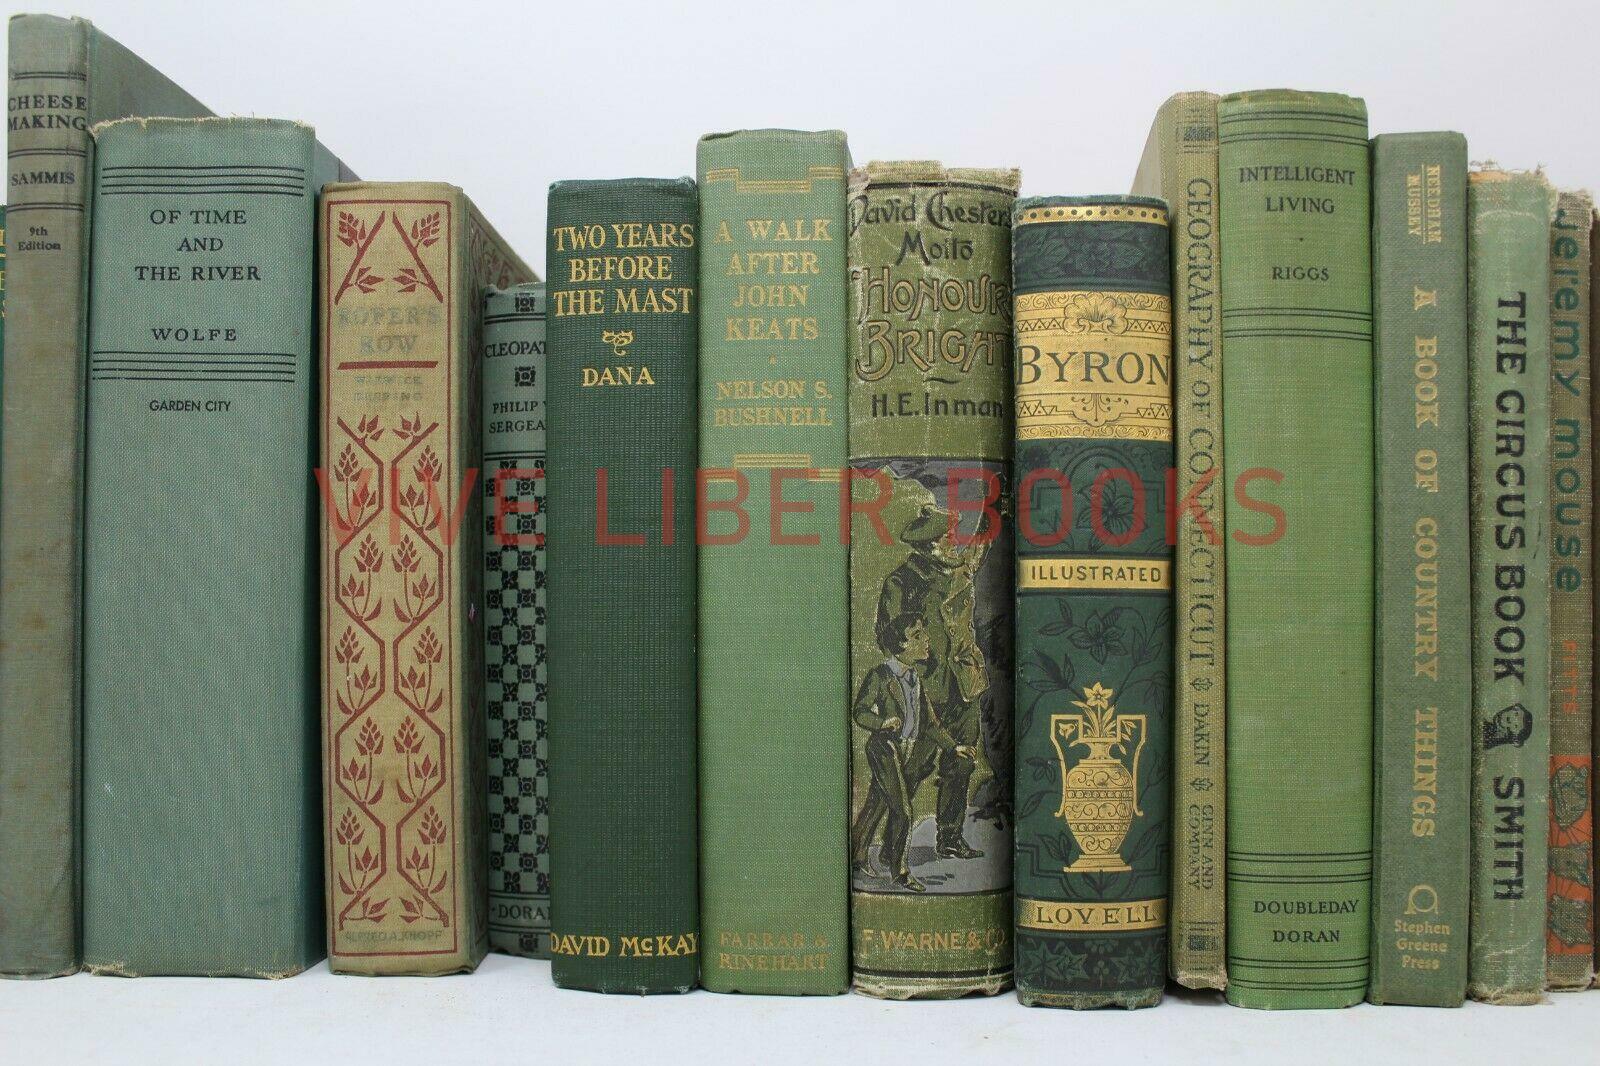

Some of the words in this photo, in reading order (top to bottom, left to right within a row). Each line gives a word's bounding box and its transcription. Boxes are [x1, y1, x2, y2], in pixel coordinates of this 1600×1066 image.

[7, 95, 87, 111] CHEESE
[7, 114, 88, 131] MAKING
[11, 171, 76, 187] SAMMIS
[1239, 165, 1355, 186] INTELLIGENT
[848, 194, 917, 236] David
[1266, 196, 1335, 214] LIVING
[1406, 173, 1422, 237] MUSSEY
[1427, 164, 1442, 244] NEEDHAM
[150, 209, 181, 225] OF
[190, 209, 247, 225] TIME
[29, 226, 48, 237] 9th
[553, 225, 606, 251] TWO
[611, 223, 694, 248] YEARS
[714, 219, 731, 242] A
[747, 218, 834, 242] WALK
[18, 240, 61, 251] Edition
[176, 237, 224, 252] AND
[135, 266, 181, 281] THE
[192, 266, 261, 281] RIVER
[569, 255, 673, 282] BEFORE
[726, 250, 820, 275] AFTER
[1272, 266, 1330, 281] RIGGS
[1187, 179, 1213, 373] GEOGRAPHY
[553, 289, 605, 317] THE
[614, 287, 694, 314] MAST
[731, 282, 809, 308] JOHN
[1413, 285, 1437, 312] A
[152, 328, 238, 342] WOLFE
[725, 318, 820, 341] KEATS
[1496, 291, 1527, 375] THE
[855, 319, 1008, 382] BRIGHT
[582, 366, 655, 388] DANA
[1017, 344, 1171, 386] BYRON
[715, 379, 807, 400] NELSON
[1414, 335, 1439, 430] BOOK
[149, 400, 201, 412] GARDEN
[205, 400, 231, 412] CITY
[493, 401, 538, 414] PHILIP
[1191, 380, 1211, 420] OF
[714, 406, 833, 427] BUSHNELL
[1414, 447, 1439, 493] OF
[1495, 388, 1526, 550] CIRCUS
[1554, 418, 1582, 593] mouse
[1188, 426, 1215, 667] CONNECTICUT
[1031, 565, 1162, 583] ILLUSTRATED
[1414, 515, 1440, 681] COUNTRY
[1493, 564, 1526, 686] BOOK
[1193, 702, 1210, 767] DAKIN
[1411, 706, 1439, 838] THINGS
[1189, 803, 1201, 891] COMPANY
[1493, 775, 1525, 901] SMITH
[1201, 854, 1214, 891] AND
[1036, 905, 1158, 925] LOVELL
[1253, 900, 1359, 914] DOUBLEDAY
[1272, 930, 1340, 943] DORAN
[1394, 920, 1451, 936] Stephen
[549, 931, 610, 957] DAVID
[1395, 938, 1449, 954] Greene
[719, 952, 831, 971] RINEHART
[1401, 954, 1441, 970] Press
